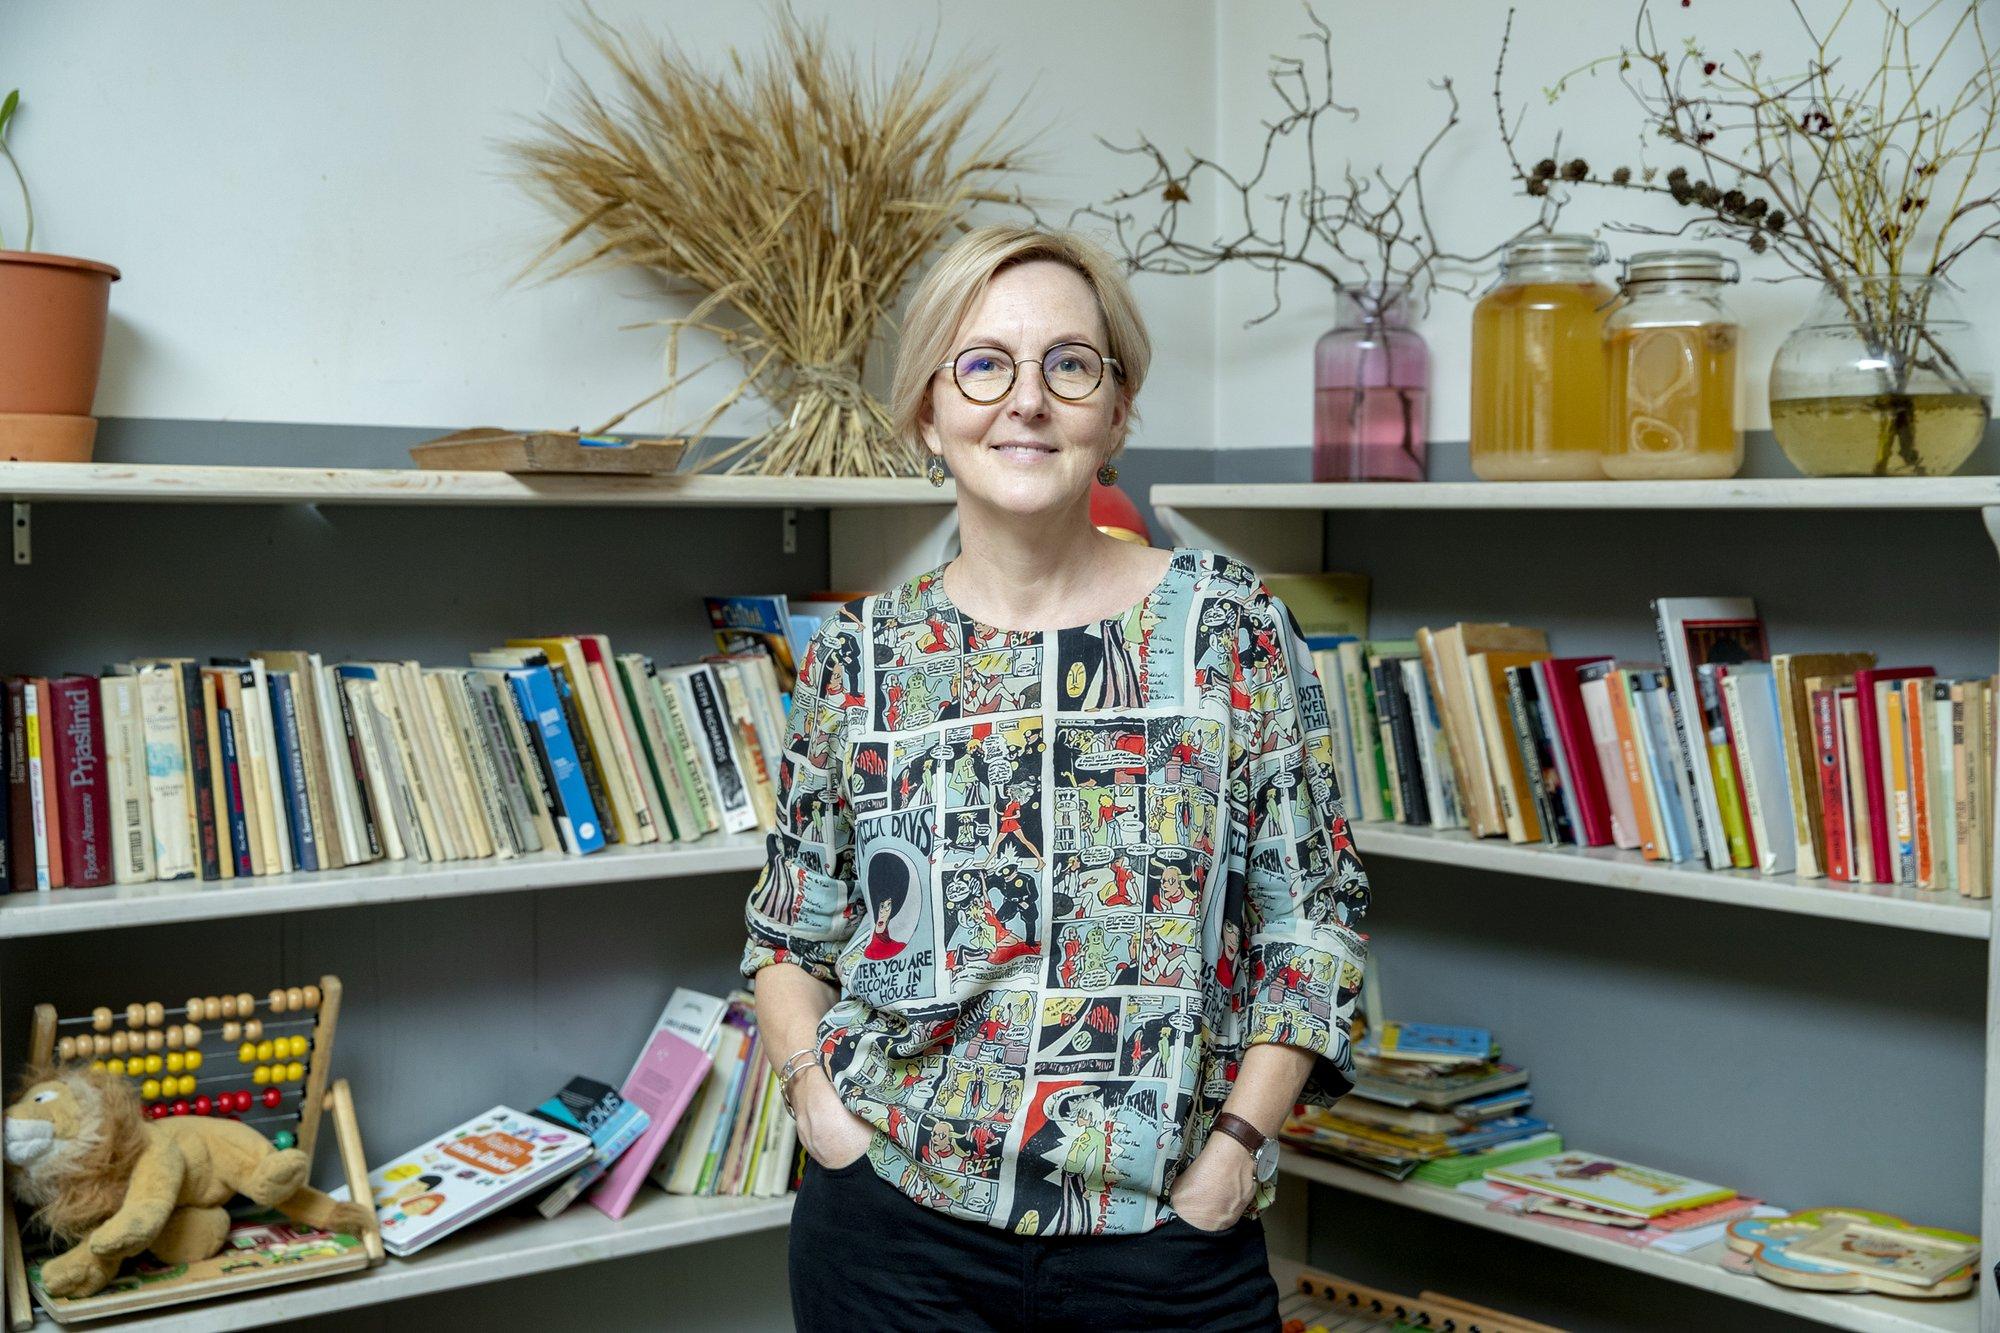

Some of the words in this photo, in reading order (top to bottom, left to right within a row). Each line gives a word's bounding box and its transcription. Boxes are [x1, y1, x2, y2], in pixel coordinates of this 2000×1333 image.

[66, 688, 98, 788] Prjaslinid
[703, 708, 729, 762] RICHARDS
[882, 958, 906, 975] YOU
[907, 949, 932, 971] ARE
[906, 969, 922, 984] IN
[879, 983, 919, 1004] HOUSE
